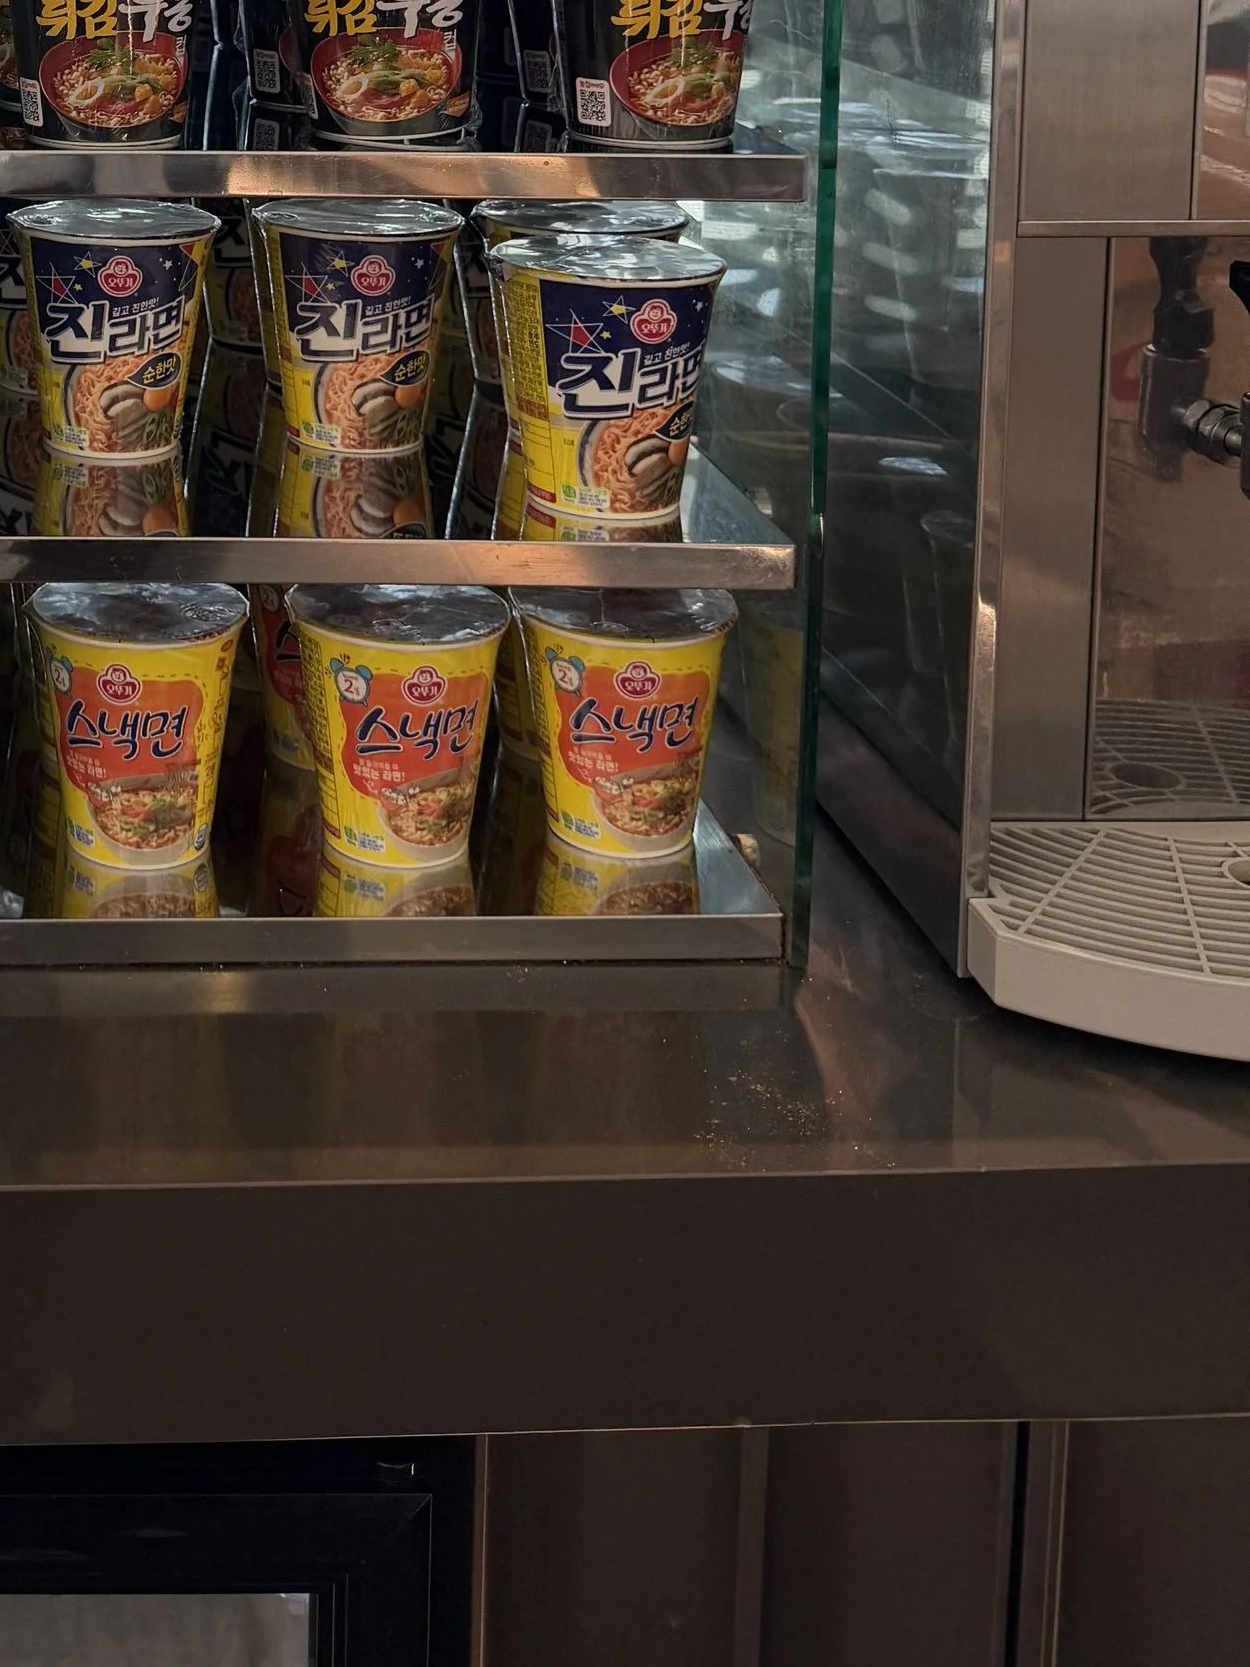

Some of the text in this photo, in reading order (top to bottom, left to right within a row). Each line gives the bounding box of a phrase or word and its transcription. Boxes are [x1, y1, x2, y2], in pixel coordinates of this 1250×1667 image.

[108, 276, 133, 288] 오뚜기
[360, 276, 387, 287] 오뚜기
[112, 306, 129, 316] 깊고
[364, 304, 382, 316] 깊고
[44, 294, 186, 364] 진라면
[294, 294, 435, 362] 진라면
[641, 322, 668, 334] 오뚜기
[644, 352, 662, 364] 깊고
[142, 357, 178, 384] 순한맛
[394, 355, 427, 382] 순한맛
[106, 684, 134, 696] 오뚜기
[410, 684, 438, 697] 오뚜기
[624, 679, 652, 691] 오뚜기
[66, 698, 189, 760] 스낵면
[355, 699, 479, 760] 스낵면
[570, 696, 699, 754] 스낵면
